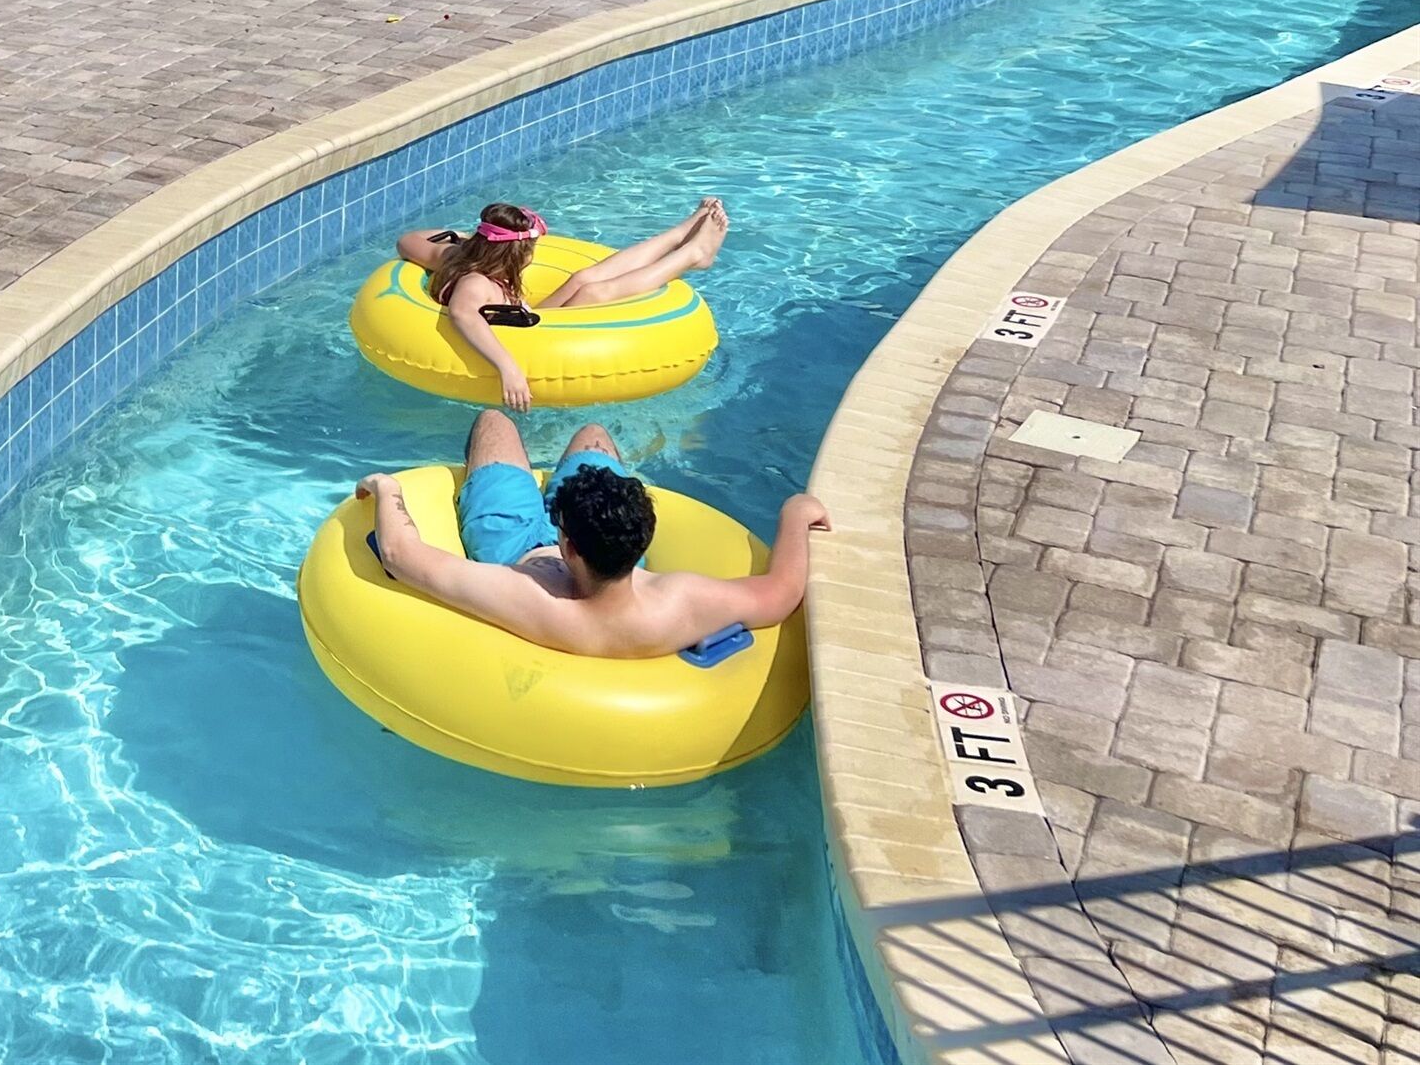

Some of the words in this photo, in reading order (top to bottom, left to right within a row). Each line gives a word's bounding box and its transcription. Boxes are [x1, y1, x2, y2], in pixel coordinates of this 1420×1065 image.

[1001, 309, 1047, 328] FT
[994, 328, 1034, 340] 3
[950, 725, 1017, 765] FT
[964, 775, 1026, 798] 3
